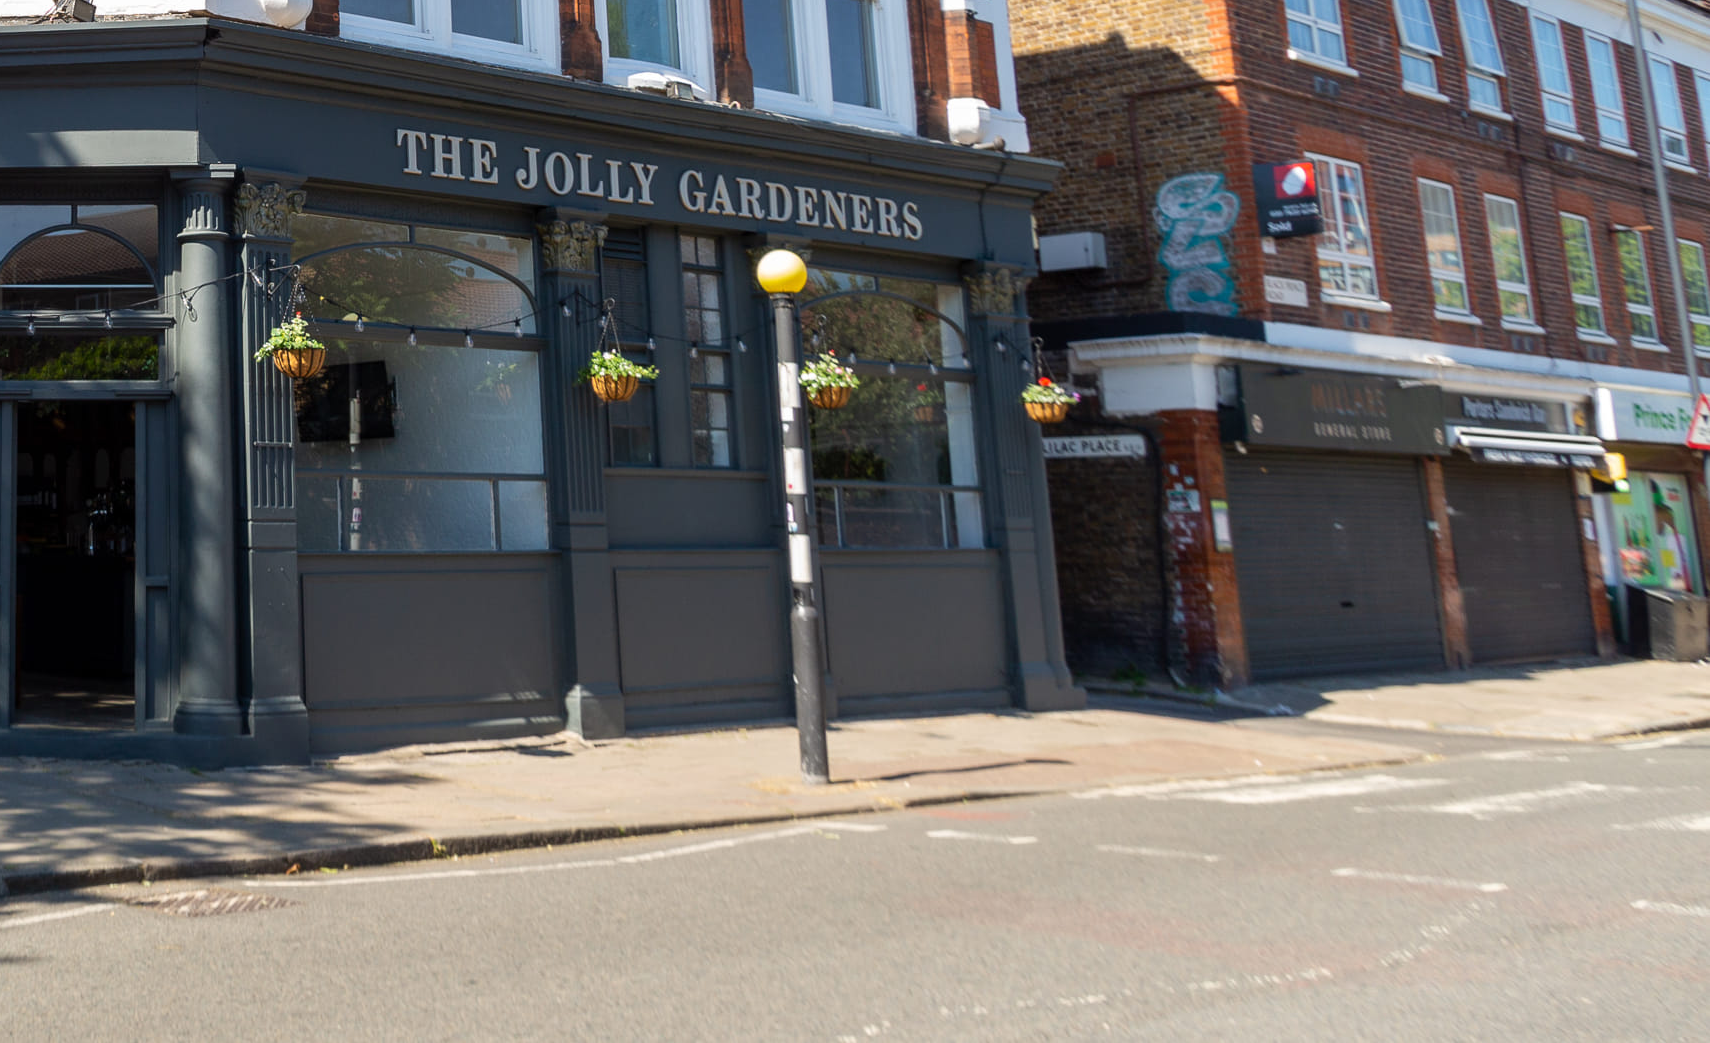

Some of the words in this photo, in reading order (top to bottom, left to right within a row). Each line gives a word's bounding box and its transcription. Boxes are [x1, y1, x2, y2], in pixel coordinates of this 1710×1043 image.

[396, 128, 500, 184] THE
[515, 146, 659, 206] JOLLY
[679, 169, 924, 242] GARDENERS
[1267, 221, 1293, 233] Sold
[1633, 402, 1676, 431] Prince
[1313, 422, 1359, 439] GENERAL
[1361, 425, 1392, 441] STORE
[1042, 440, 1076, 454] LILAC
[1081, 439, 1121, 453] PLACE
